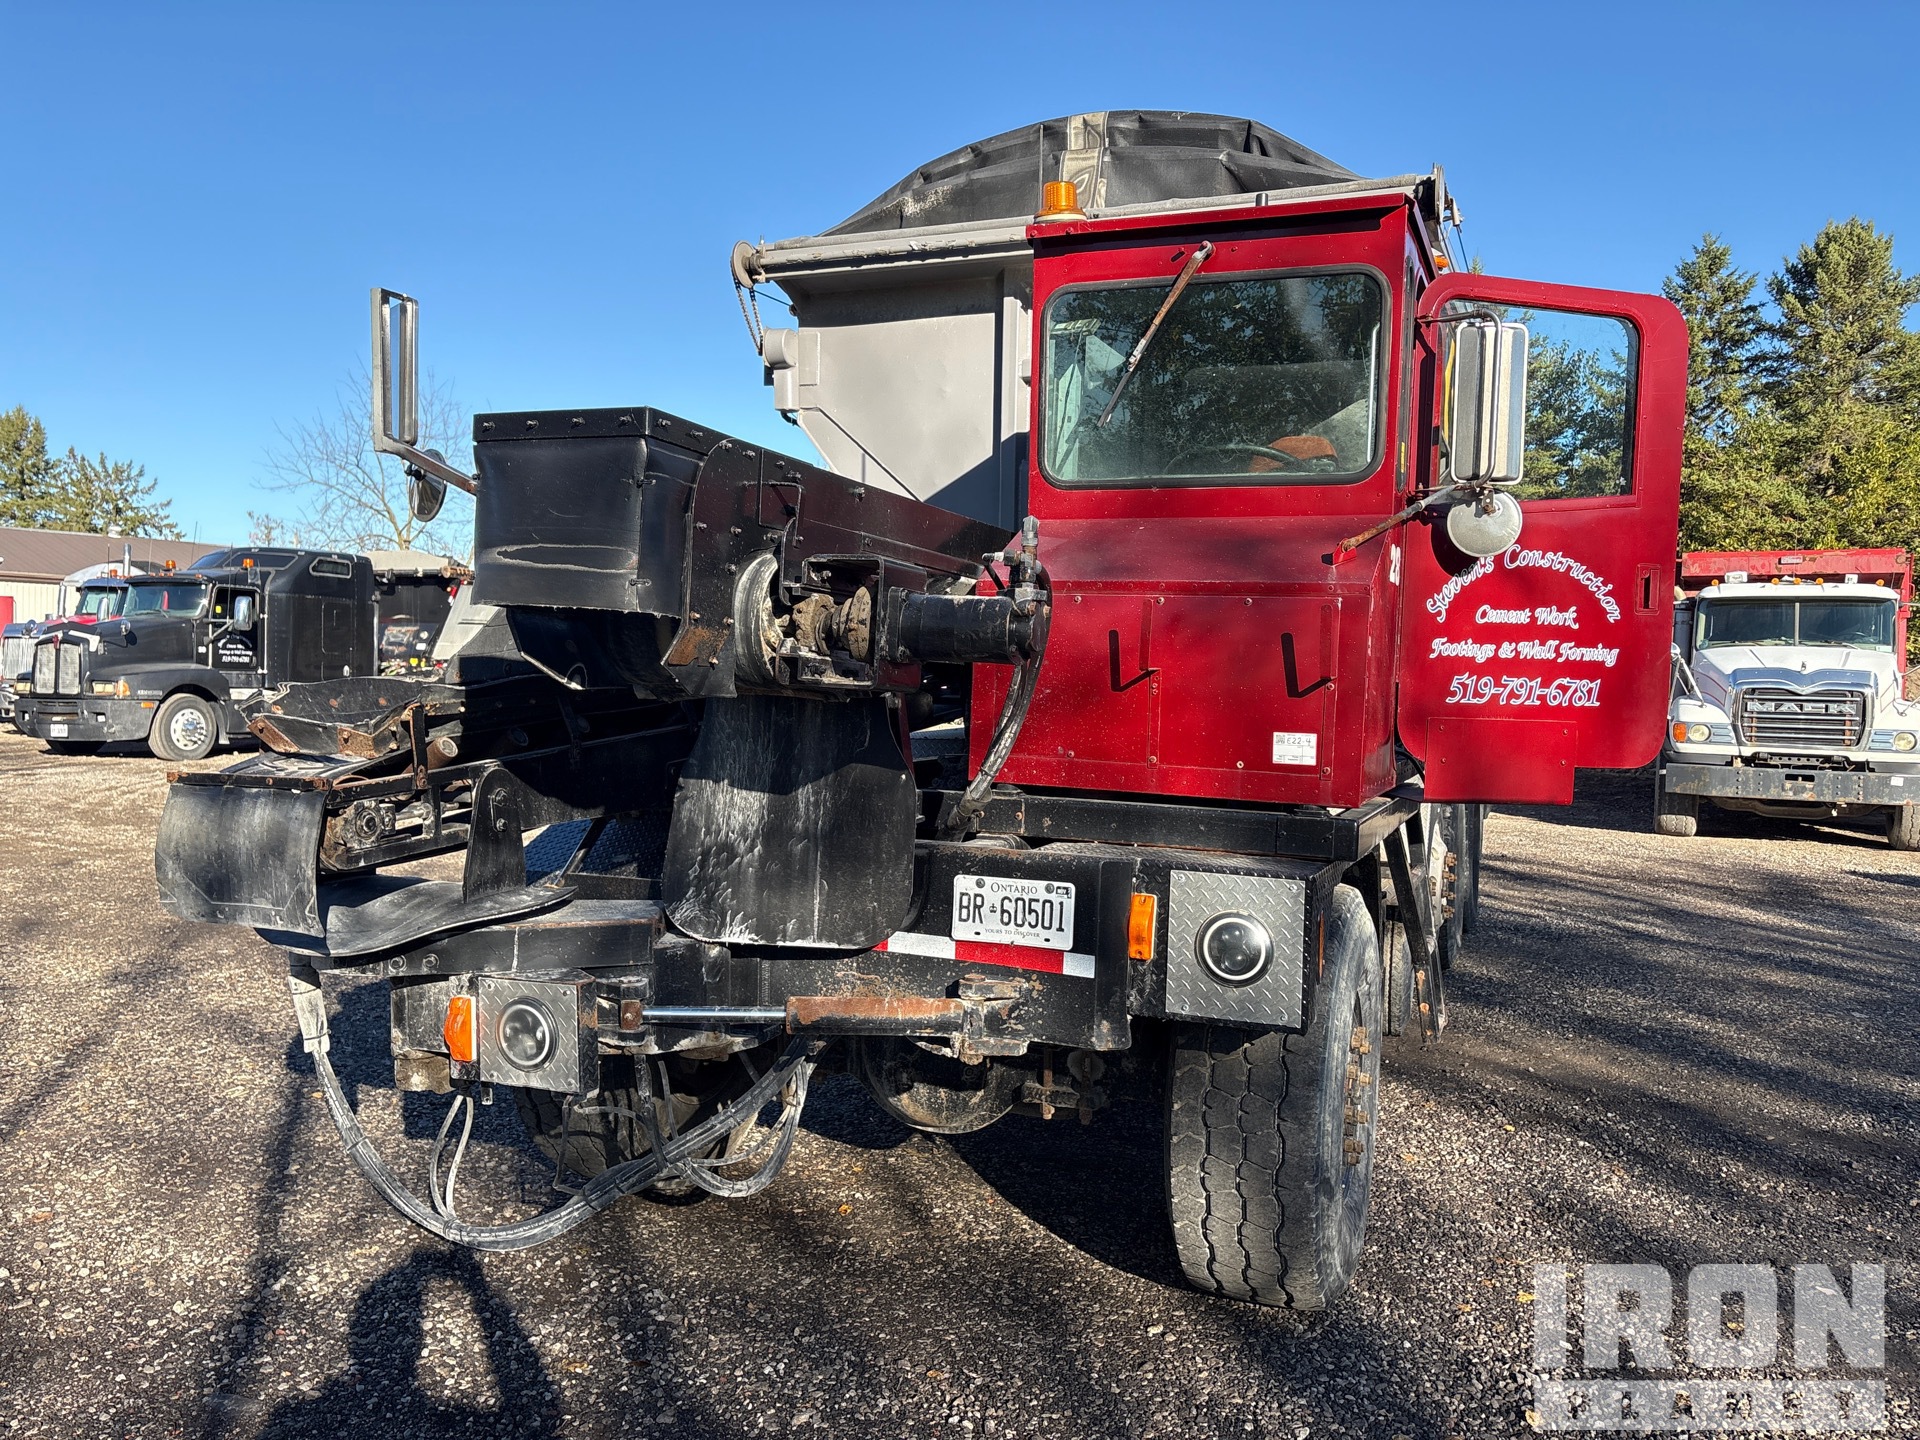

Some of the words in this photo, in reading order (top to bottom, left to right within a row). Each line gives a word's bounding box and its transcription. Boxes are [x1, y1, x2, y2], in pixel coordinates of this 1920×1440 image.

[1389, 543, 1401, 586] 28
[1426, 555, 1495, 623] Steven's
[1504, 544, 1621, 624] Construction
[1475, 605, 1531, 624] Cement
[1535, 605, 1579, 629] Work
[1429, 637, 1496, 663] Footings
[1498, 641, 1515, 658] &
[1518, 640, 1558, 659] Wall
[1557, 642, 1620, 667] Forming
[1446, 672, 1602, 707] 519-791-6781
[1747, 702, 1856, 714] MACK
[990, 881, 1038, 895] ONTARIO
[958, 891, 985, 924] BR
[999, 895, 1065, 932] 60501
[1013, 930, 1040, 938] DISCOVER
